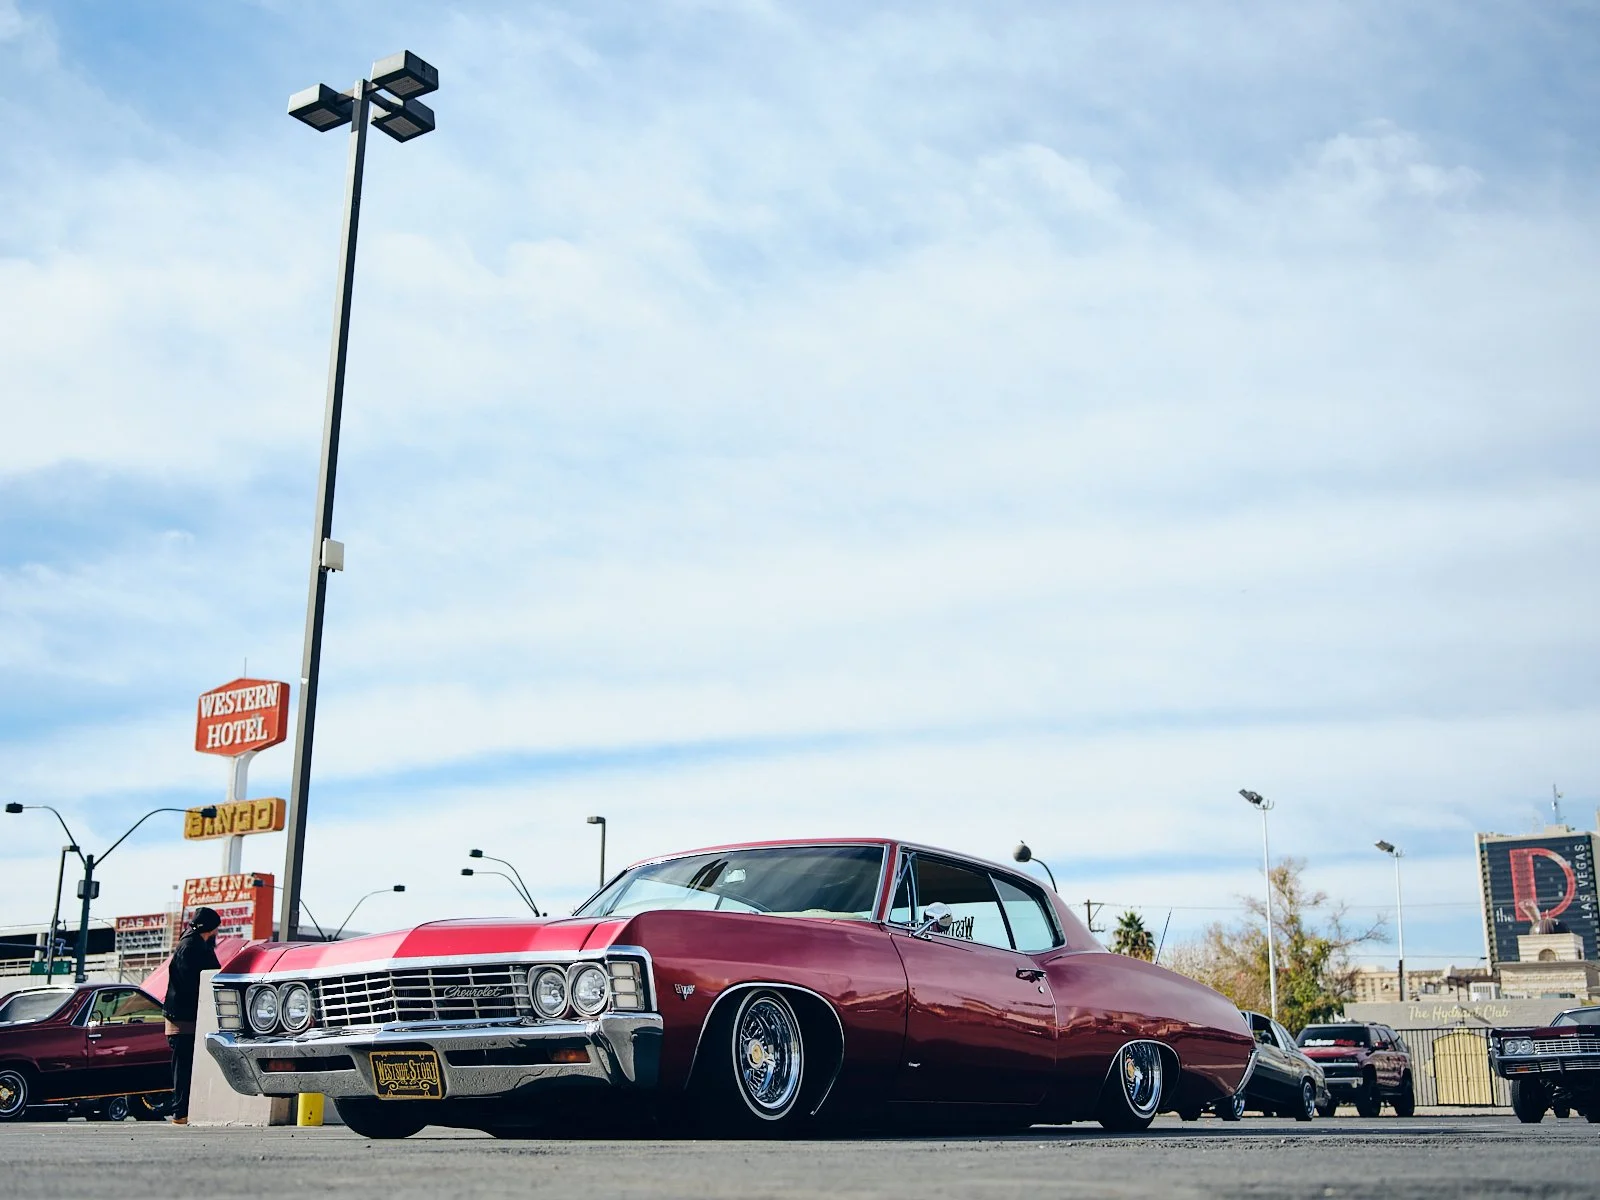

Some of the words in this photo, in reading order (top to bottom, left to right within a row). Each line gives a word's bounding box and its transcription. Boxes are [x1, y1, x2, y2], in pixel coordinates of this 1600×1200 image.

[200, 683, 280, 718] WESTERN
[206, 716, 267, 749] HOTEL
[188, 801, 271, 837] BINGO
[1574, 844, 1588, 887] VEGAS
[186, 875, 255, 894] CASINO
[1496, 907, 1514, 922] the
[1509, 848, 1575, 921] D
[1579, 895, 1592, 919] LAS
[444, 985, 503, 998] Chevrolet
[1408, 1005, 1429, 1020] The
[1483, 1004, 1510, 1019] Club
